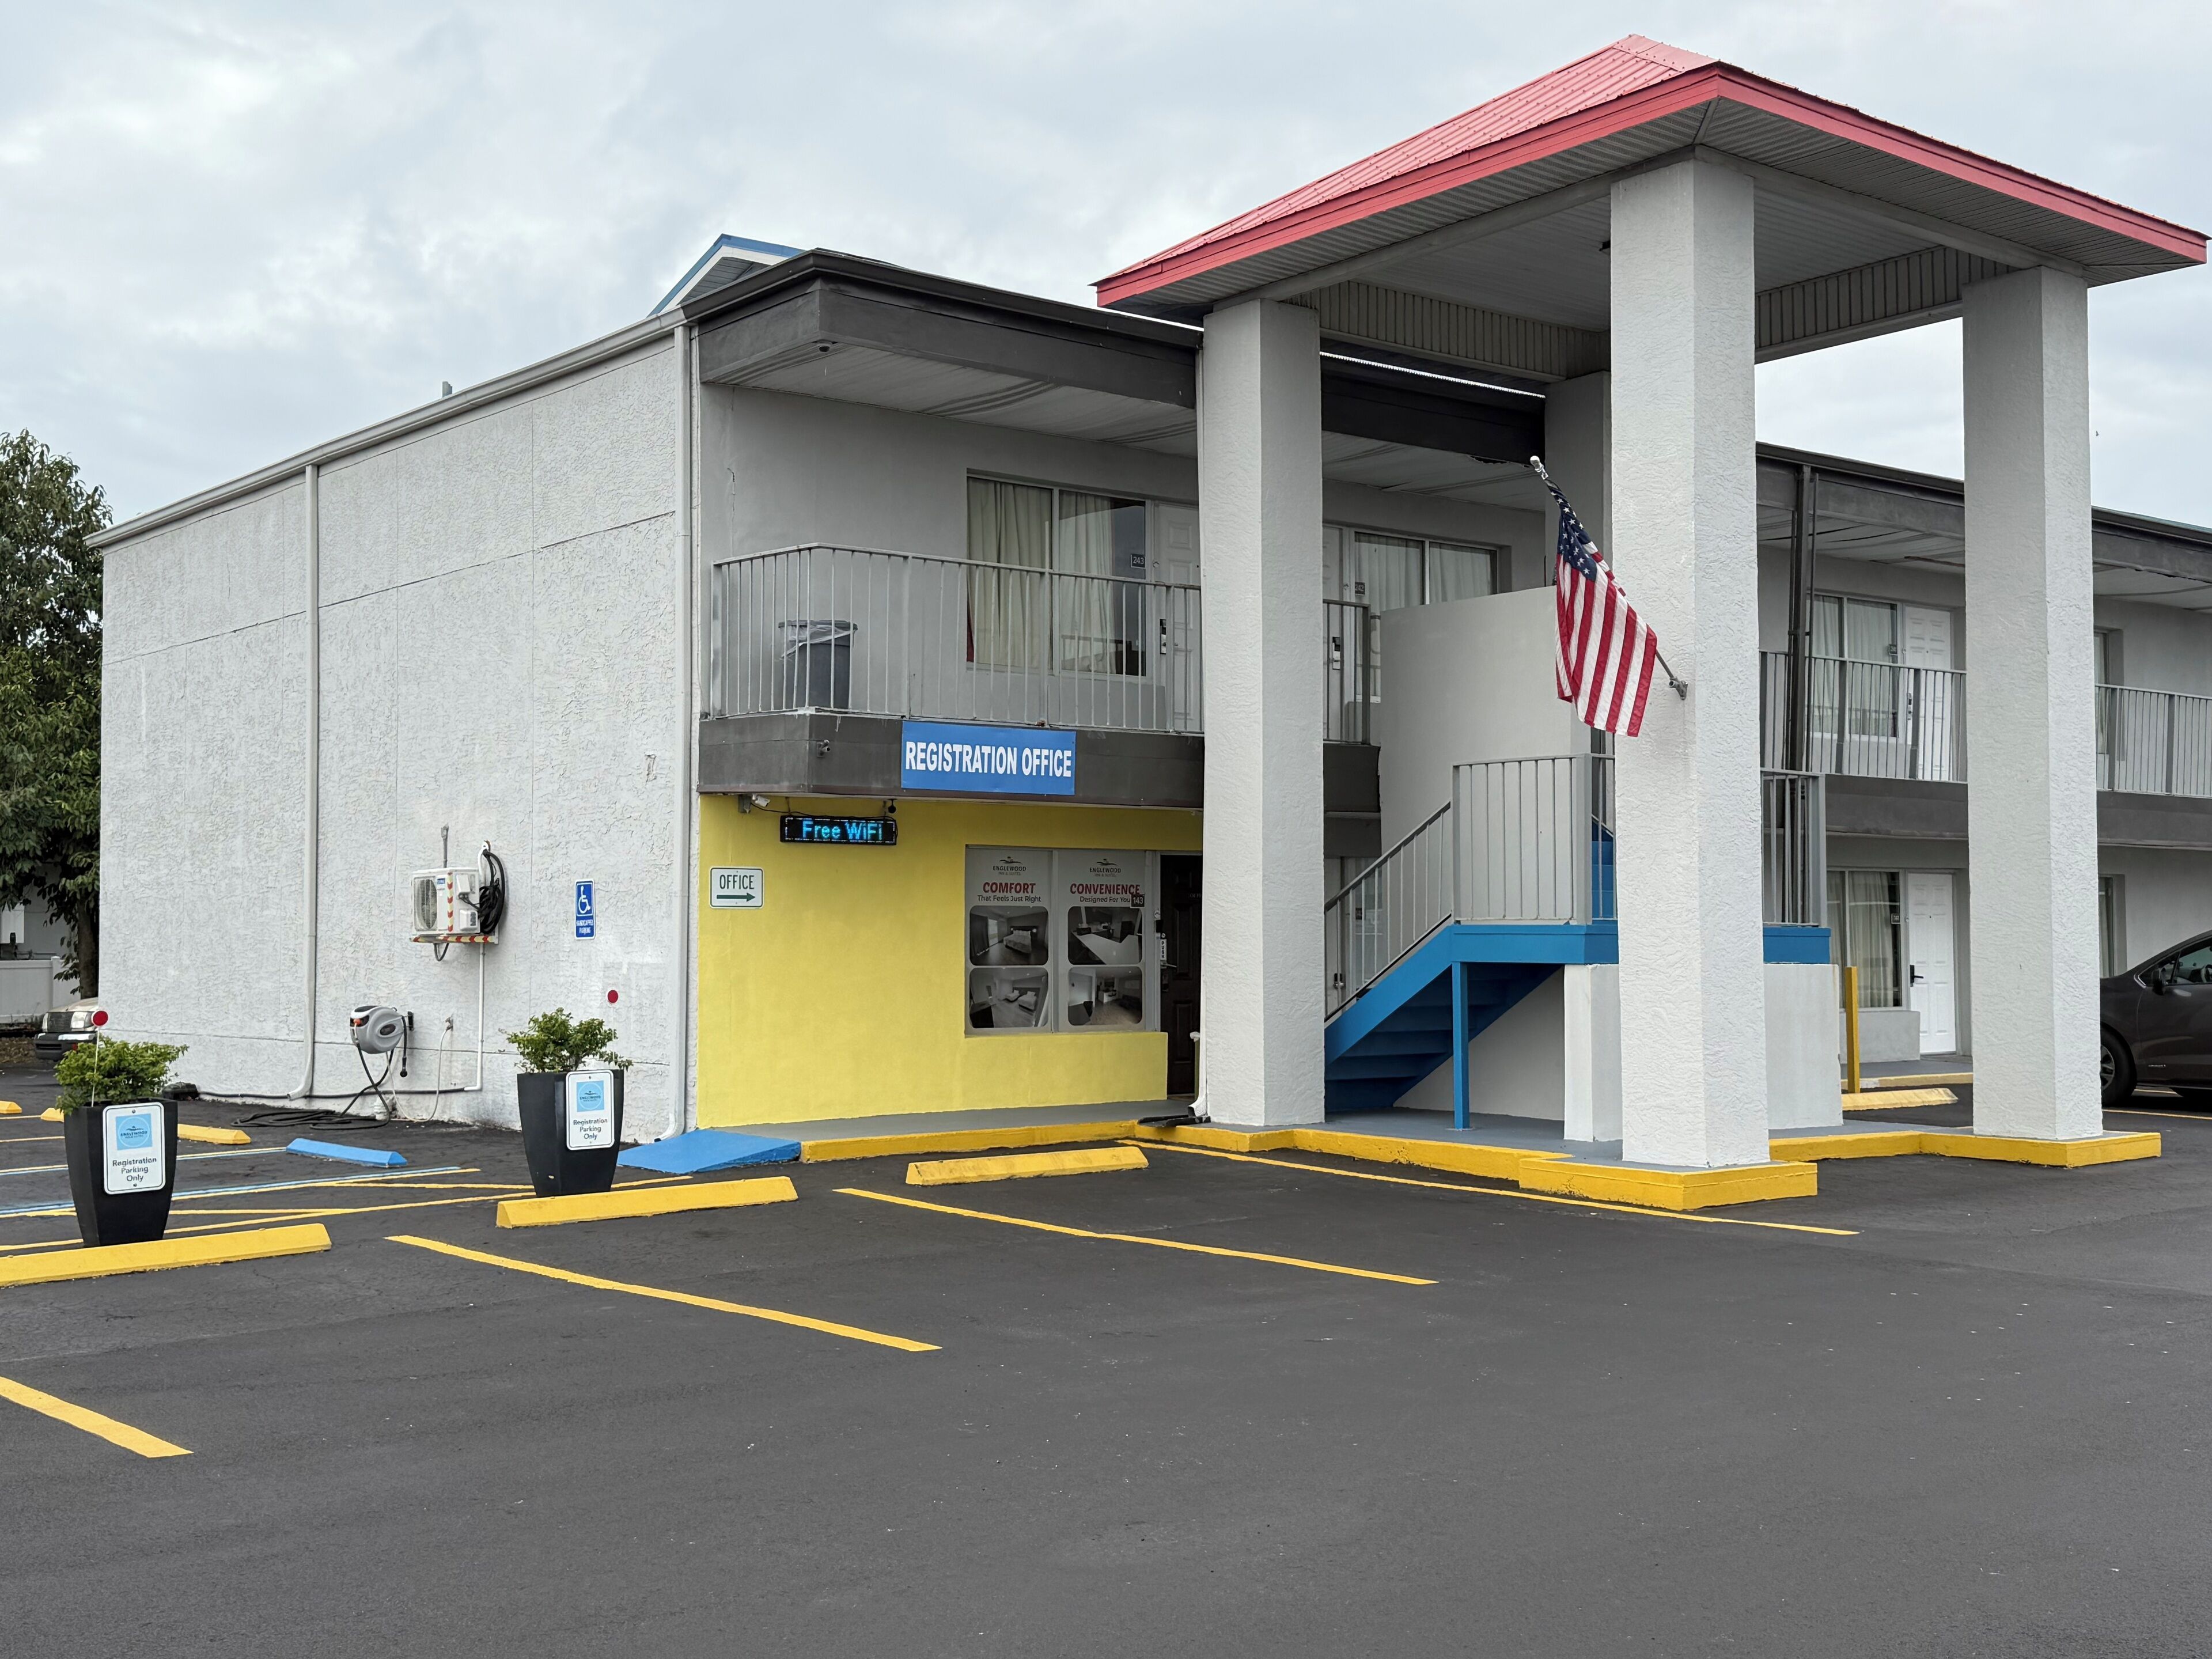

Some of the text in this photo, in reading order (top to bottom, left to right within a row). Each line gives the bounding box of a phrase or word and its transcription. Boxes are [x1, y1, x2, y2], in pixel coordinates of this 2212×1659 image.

[1132, 556, 1144, 565] 243
[906, 741, 1071, 777] REGISTRATION OFFICE
[802, 820, 882, 840] Free WiFi
[719, 874, 755, 889] OFFICE
[983, 882, 1036, 893] COMFORT
[1070, 883, 1140, 895] CONVENIENCE
[112, 1157, 157, 1167] Registration
